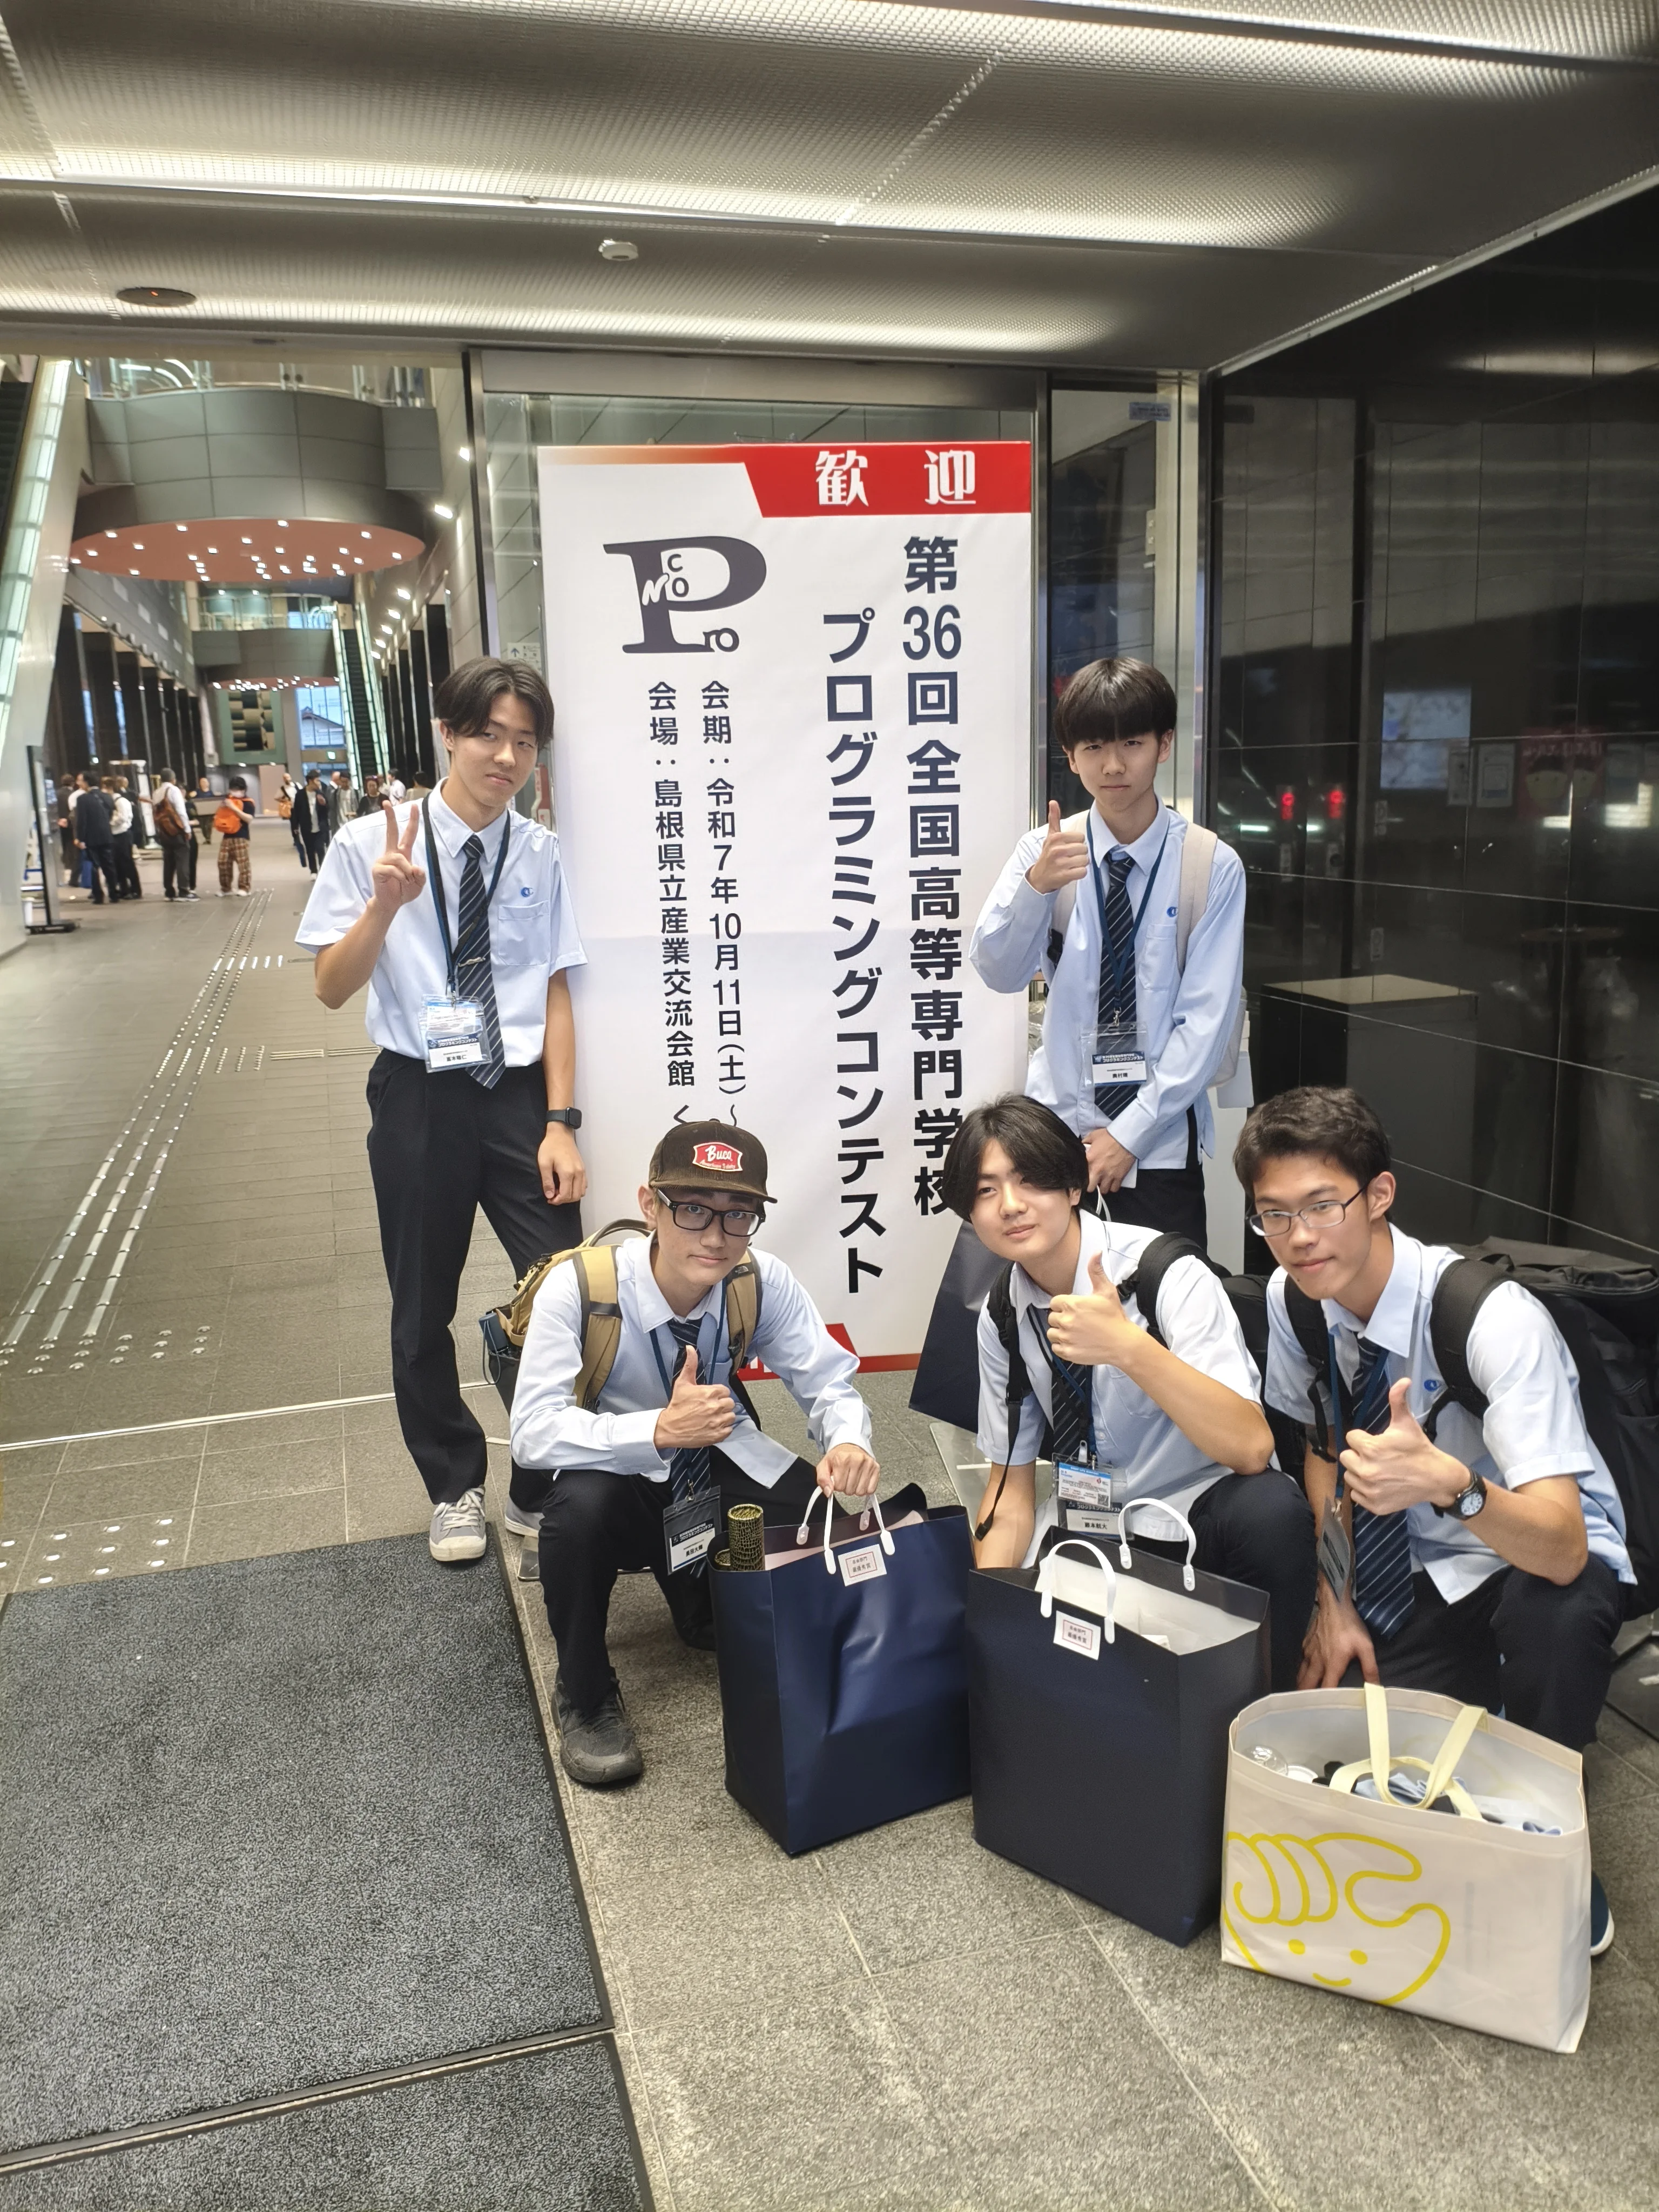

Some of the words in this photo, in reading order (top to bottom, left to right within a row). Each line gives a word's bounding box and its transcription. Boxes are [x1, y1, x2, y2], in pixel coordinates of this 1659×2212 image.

[824, 608, 886, 1293] プログラミングコンテスト
[903, 536, 963, 1216] 第36回全国高等専門学校
